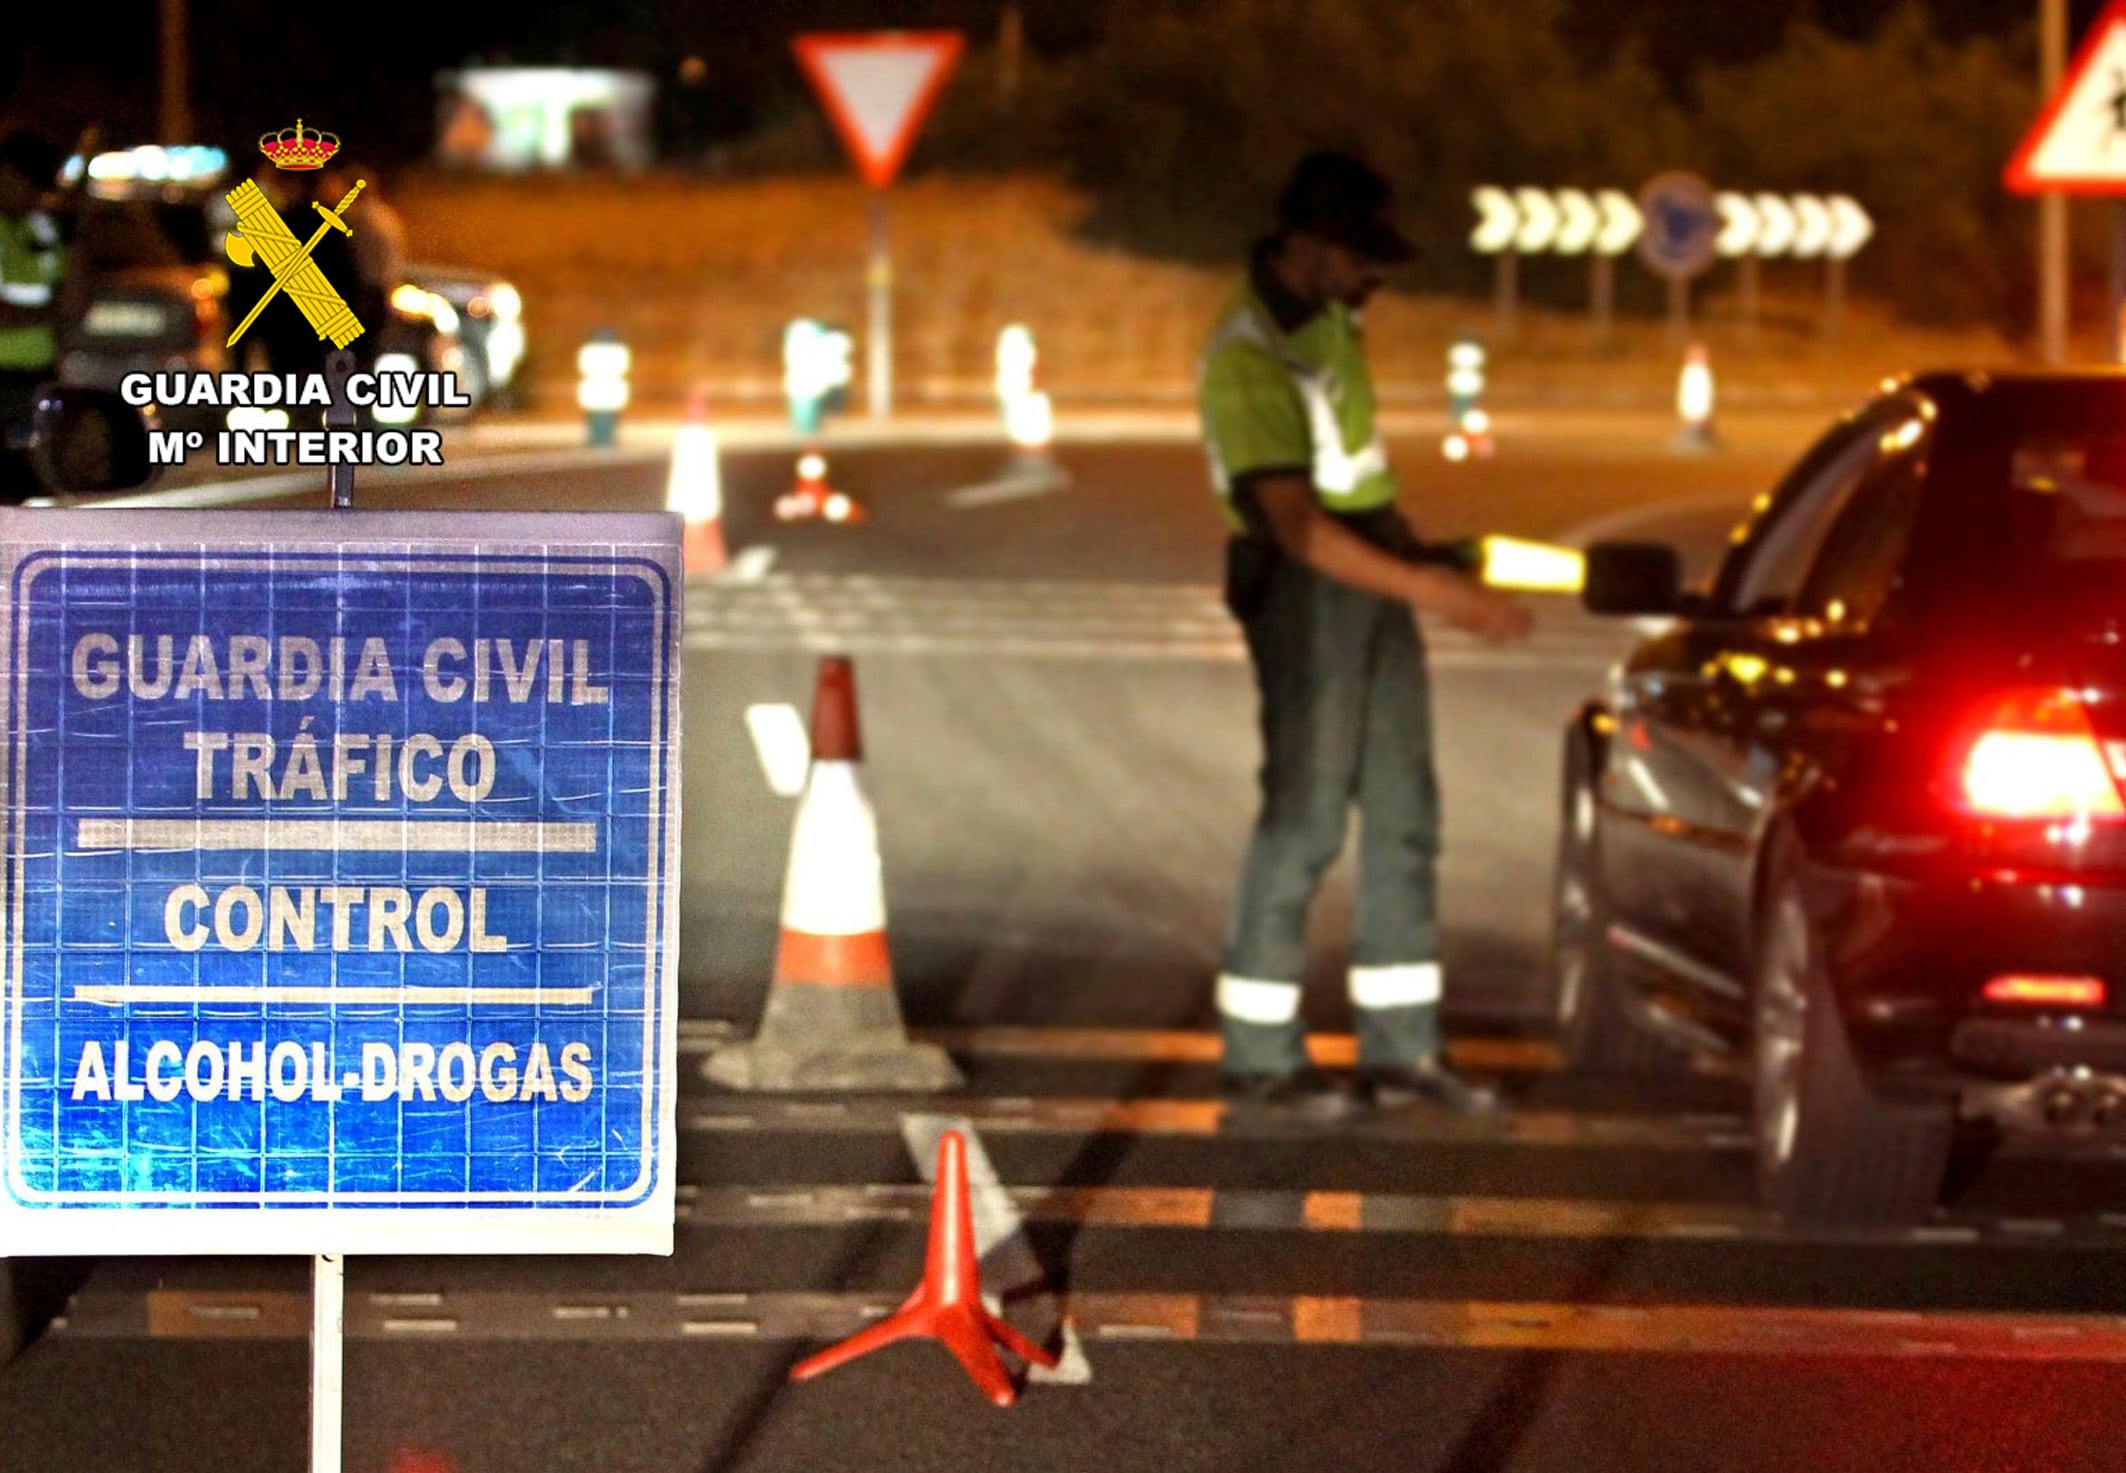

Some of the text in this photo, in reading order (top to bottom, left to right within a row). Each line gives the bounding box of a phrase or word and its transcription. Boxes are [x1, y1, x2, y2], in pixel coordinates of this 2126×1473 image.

[71, 633, 609, 706] GUARDIA CIVIL
[183, 717, 497, 802] TRÁFICO
[164, 884, 508, 953] CONTROL
[71, 1039, 594, 1102] ALCOHOL-DROGAS
